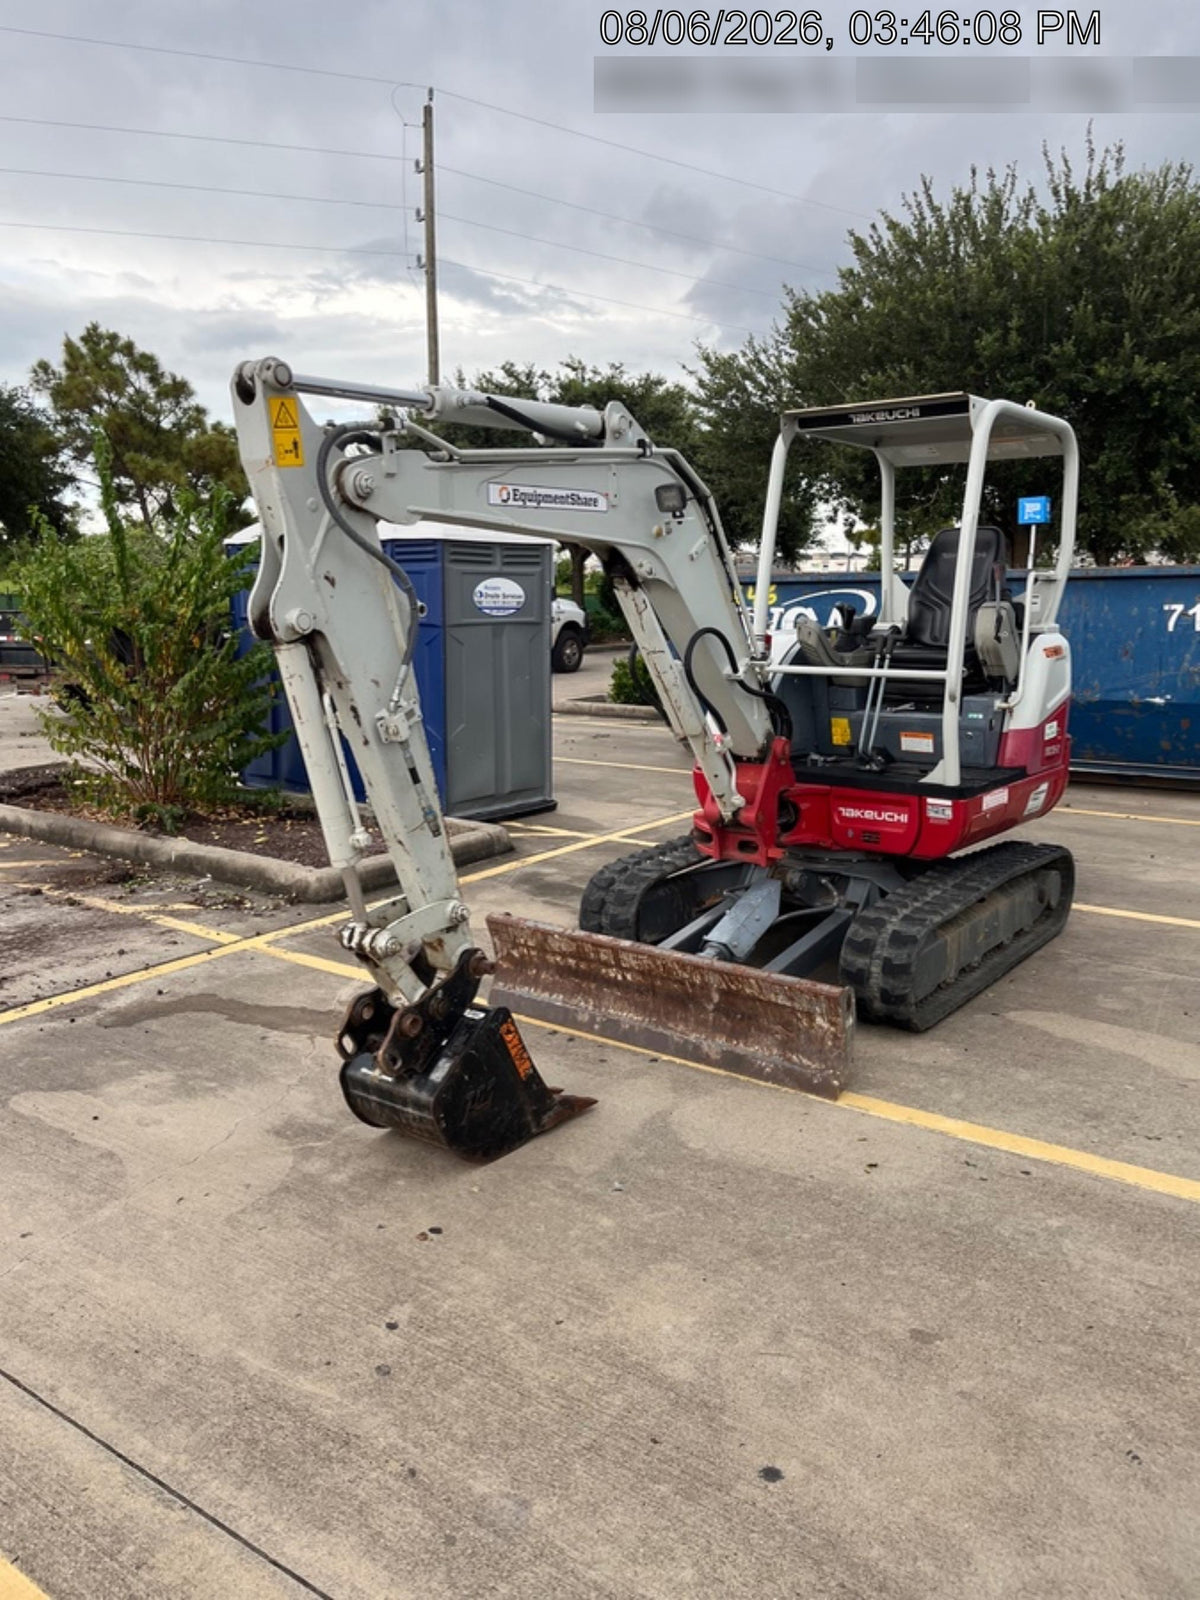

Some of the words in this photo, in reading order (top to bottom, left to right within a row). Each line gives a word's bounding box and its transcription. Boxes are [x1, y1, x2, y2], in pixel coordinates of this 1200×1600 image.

[848, 407, 920, 424] TAKEUCHI
[511, 488, 598, 508] EquipmentShare
[838, 806, 909, 824] TAKEUCHI
